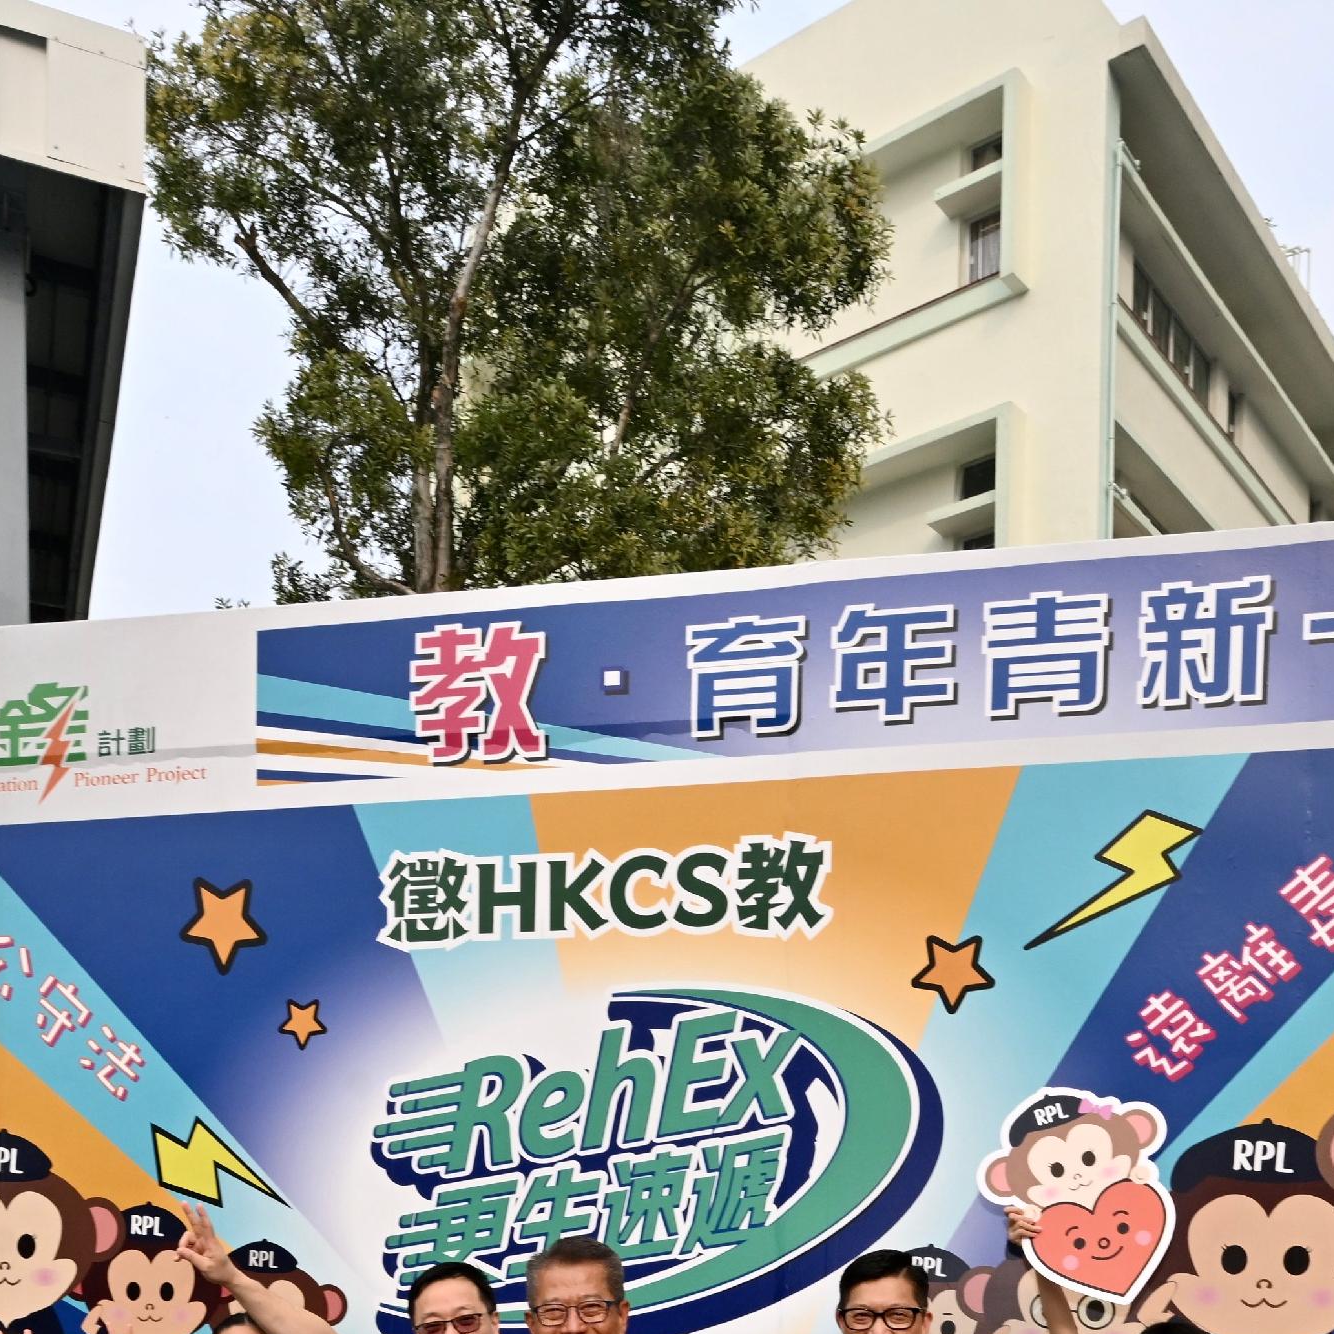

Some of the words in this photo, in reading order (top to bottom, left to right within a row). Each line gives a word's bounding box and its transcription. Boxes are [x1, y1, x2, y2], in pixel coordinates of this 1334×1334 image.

[74, 771, 140, 787] Pioneer
[146, 766, 208, 785] Project
[373, 1010, 801, 1174] RehEx
[1033, 1101, 1070, 1127] RPL
[1232, 1138, 1295, 1174] RPL
[130, 1214, 165, 1238] RPL
[248, 1250, 279, 1270] RPL
